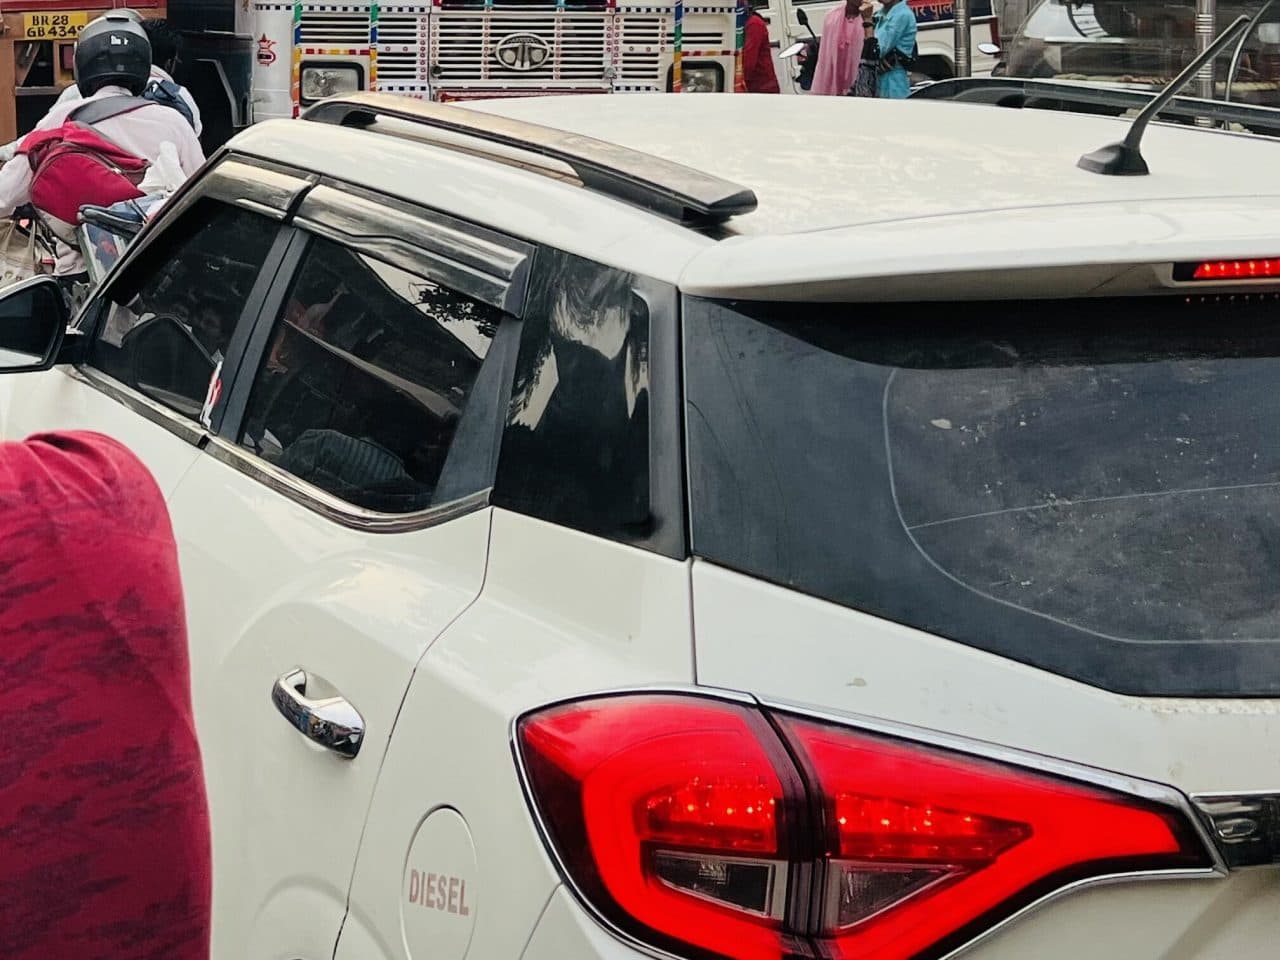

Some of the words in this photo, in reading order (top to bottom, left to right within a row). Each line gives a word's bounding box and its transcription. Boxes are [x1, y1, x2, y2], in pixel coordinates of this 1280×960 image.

[32, 15, 49, 25] BR
[52, 15, 69, 25] 28
[409, 868, 469, 916] DIESEL
